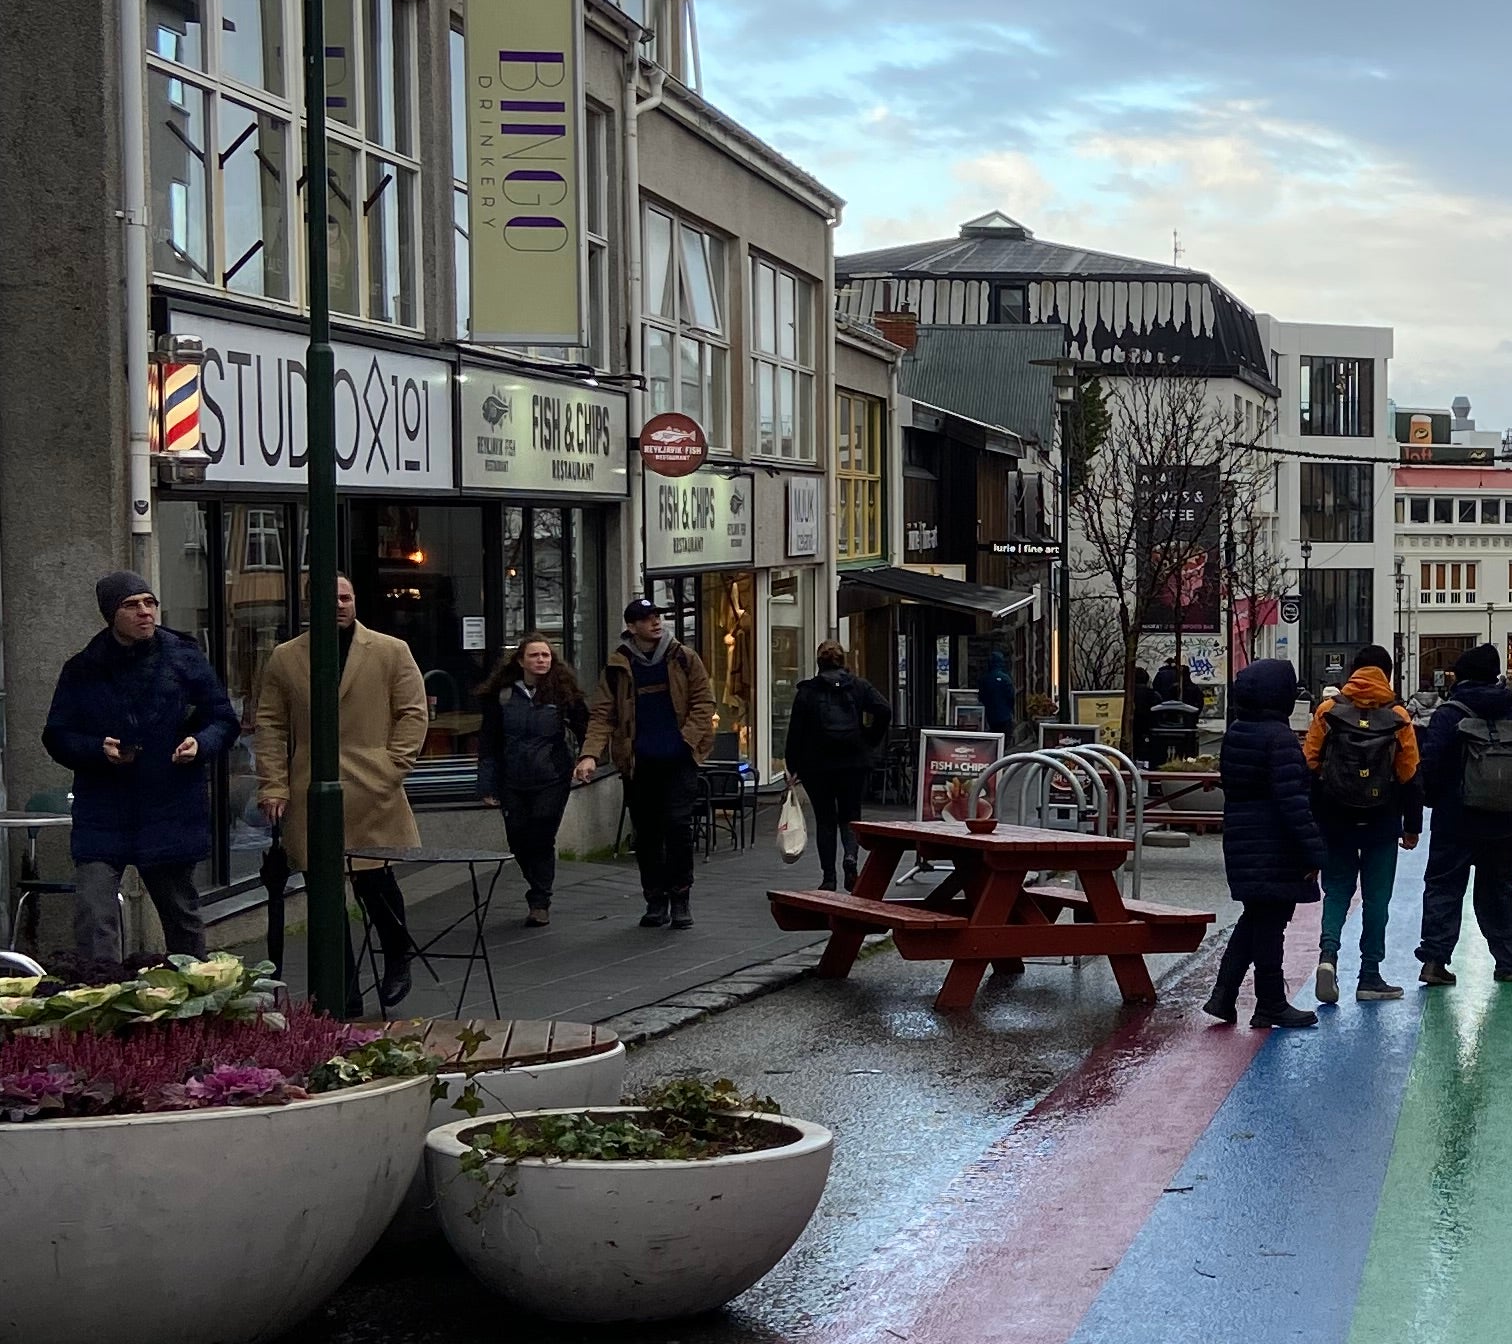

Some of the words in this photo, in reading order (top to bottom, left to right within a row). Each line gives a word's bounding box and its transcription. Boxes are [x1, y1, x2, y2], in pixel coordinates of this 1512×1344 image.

[477, 75, 496, 229] DRINKERY
[499, 50, 569, 253] BINGO
[201, 347, 361, 470] STUDO
[391, 375, 430, 472] 101
[532, 394, 561, 451] FISH
[564, 403, 574, 452] &
[577, 402, 610, 456] CHIPS
[685, 446, 702, 455] FISH
[552, 459, 594, 481] RESTAURANT
[1193, 490, 1204, 503] &
[659, 485, 680, 532] FISH
[682, 489, 689, 531] &
[691, 487, 715, 531] CHIPS
[1141, 509, 1195, 521] FFEE
[1023, 544, 1044, 553] fine
[1045, 545, 1060, 554] art
[930, 760, 953, 771] FISH
